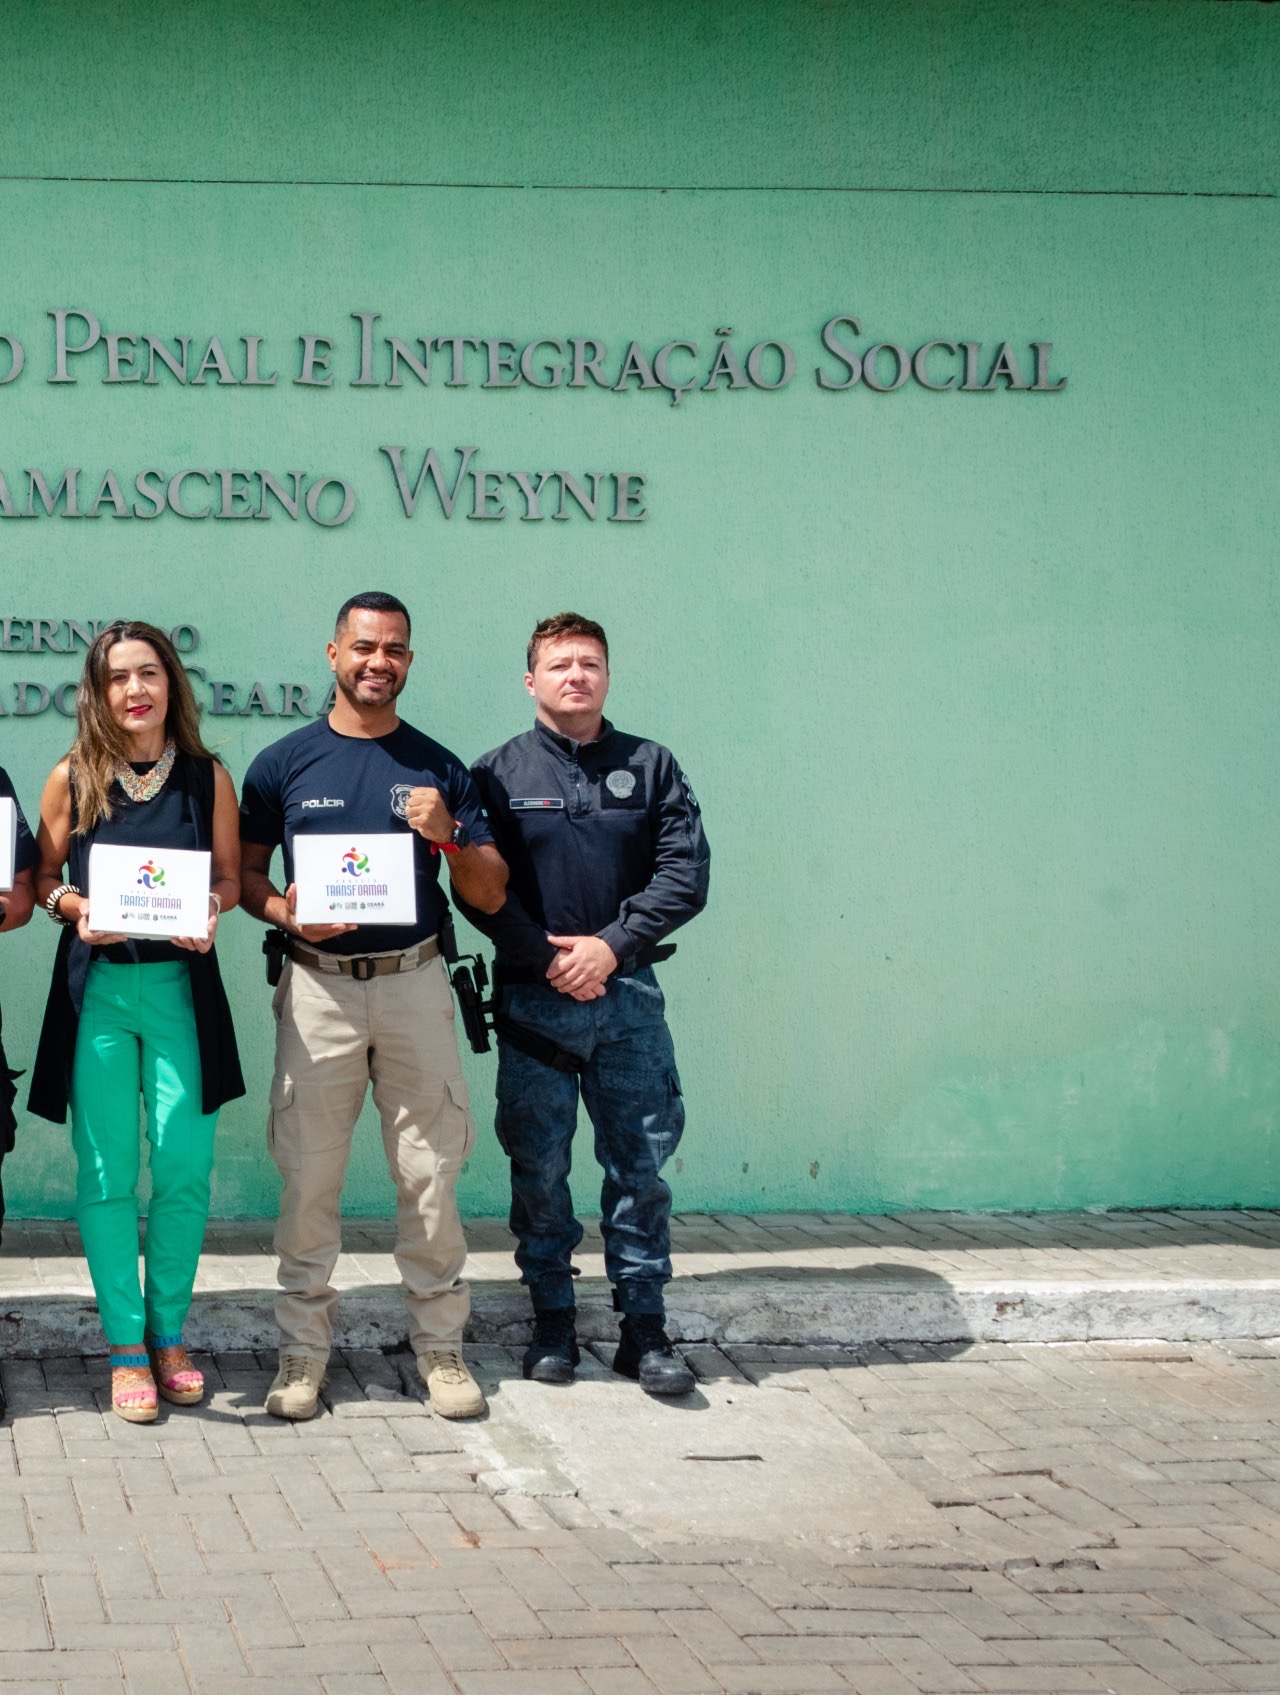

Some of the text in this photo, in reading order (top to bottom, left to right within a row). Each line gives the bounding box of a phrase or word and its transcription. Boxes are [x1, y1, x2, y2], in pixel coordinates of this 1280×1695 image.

[47, 308, 278, 386] PENAL
[293, 335, 334, 387] E
[350, 311, 797, 407] INTEGRAÇÃO
[816, 315, 1068, 393] SOCIAL
[379, 445, 649, 523] WEYNE
[167, 623, 201, 653] O
[302, 797, 345, 810] POLÍCIA
[325, 884, 388, 896] TRANSFORMAR
[119, 894, 182, 910] TRANSFORMAR
